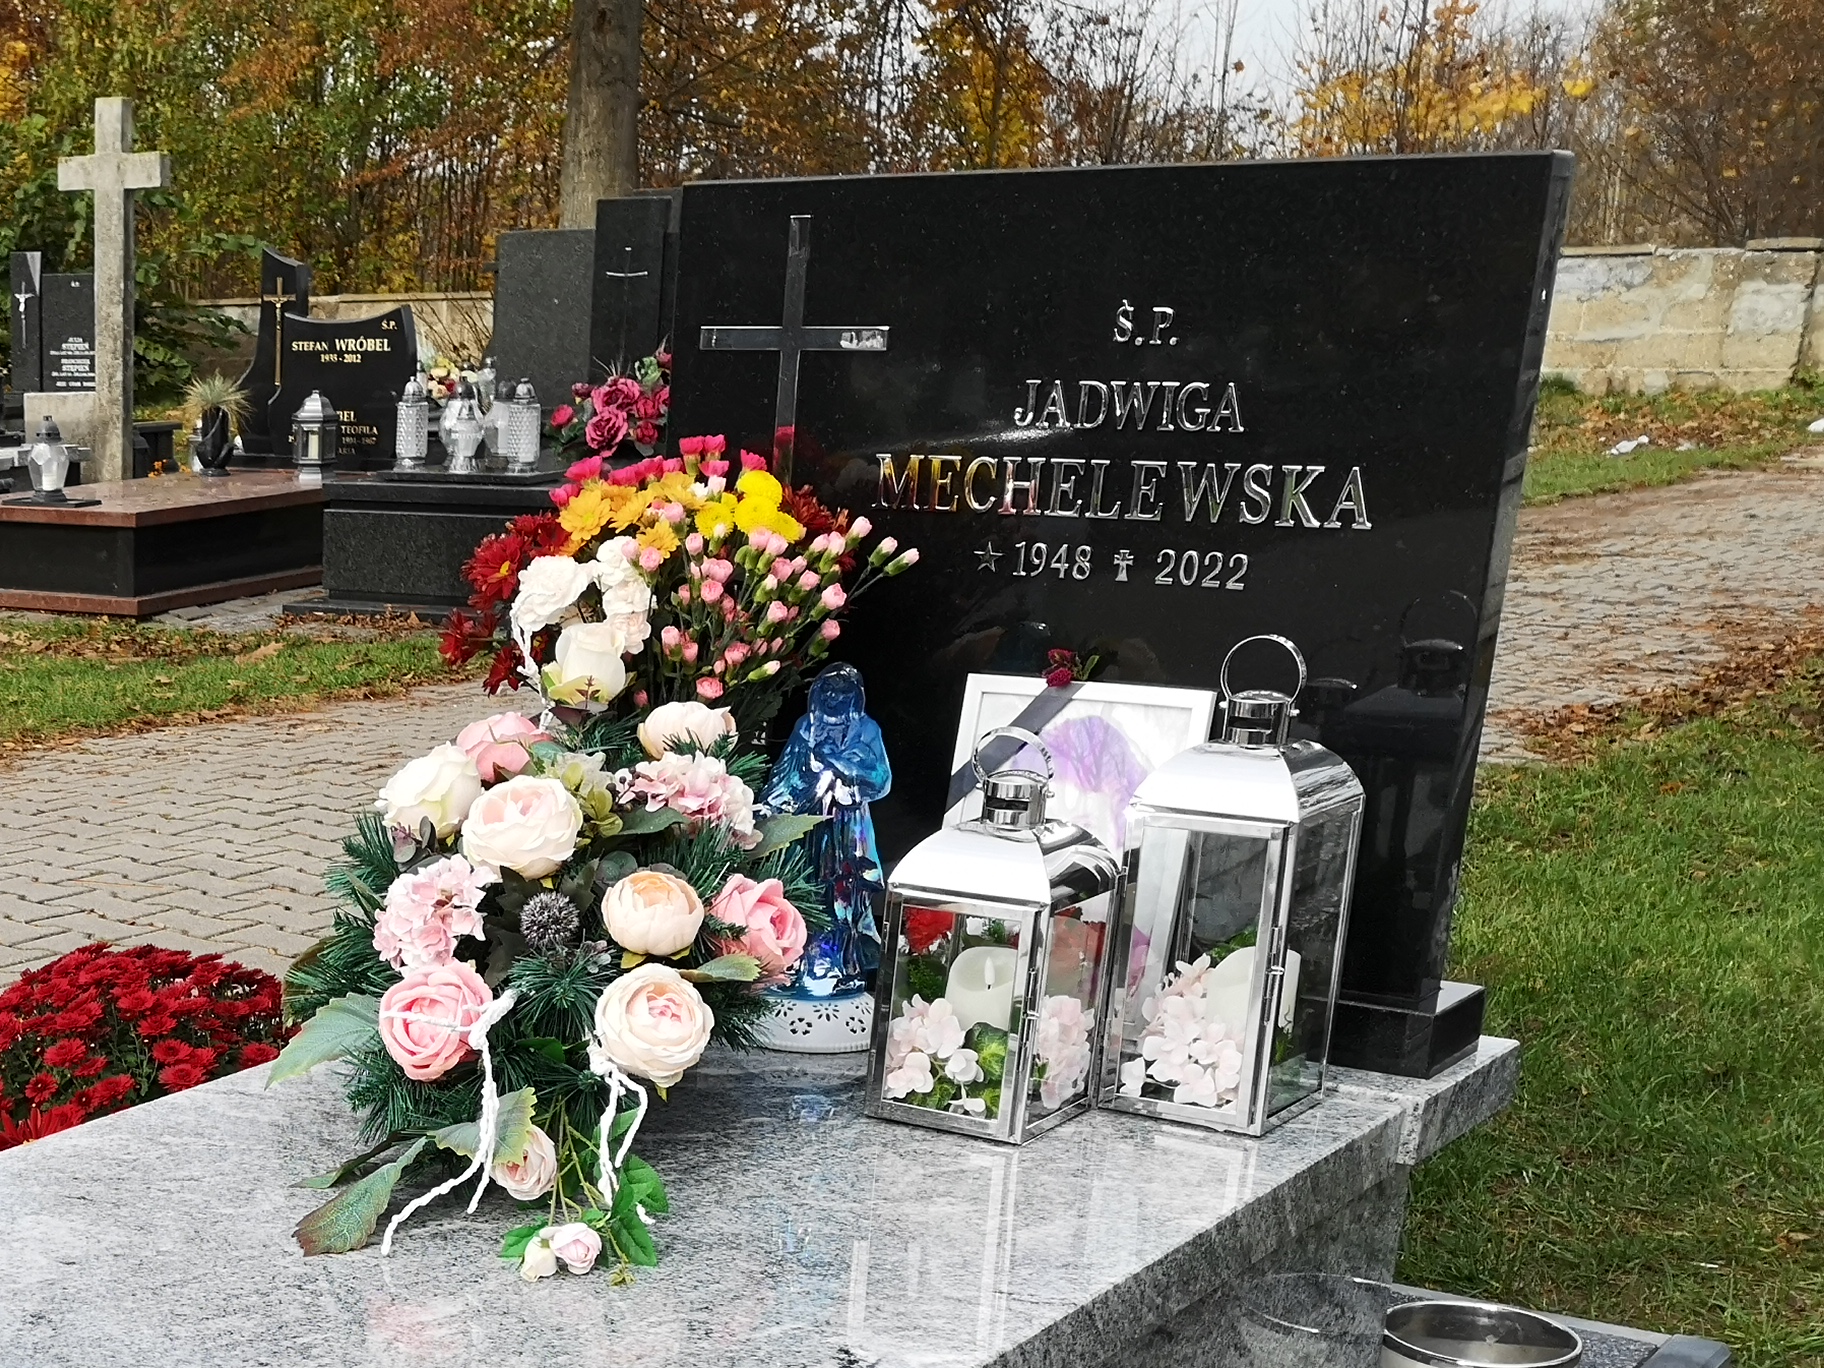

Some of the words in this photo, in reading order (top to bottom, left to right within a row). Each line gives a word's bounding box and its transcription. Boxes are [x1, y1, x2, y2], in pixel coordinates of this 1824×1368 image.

[291, 341, 329, 351] STEFAN
[334, 335, 392, 352] WRÓBEL
[1113, 299, 1180, 346] Ś.P.
[1013, 379, 1245, 433] JADWIGA
[871, 453, 1373, 530] MECHELEWSKA
[1012, 541, 1092, 580] 1948
[1155, 549, 1249, 590] 2022
